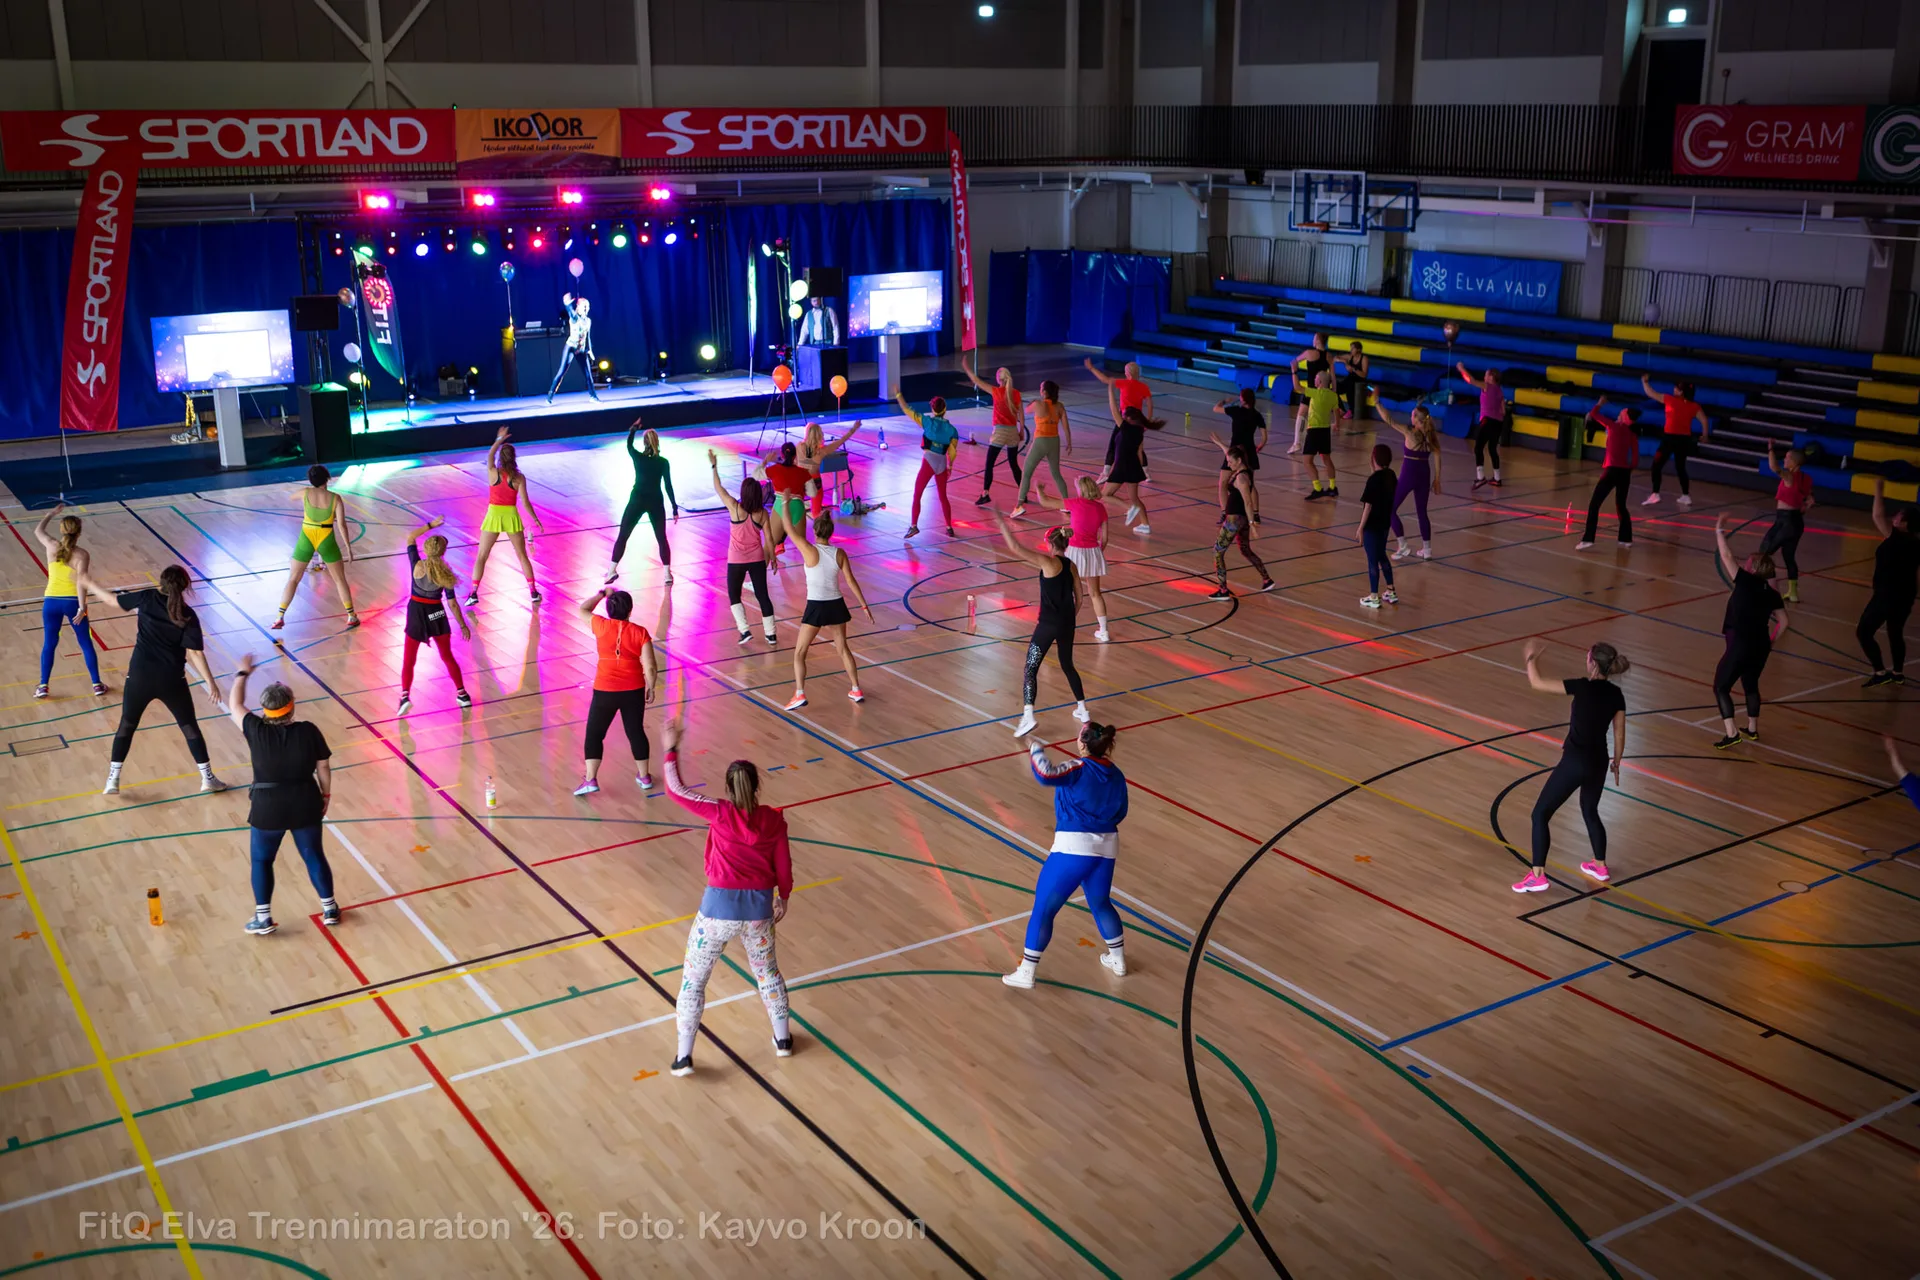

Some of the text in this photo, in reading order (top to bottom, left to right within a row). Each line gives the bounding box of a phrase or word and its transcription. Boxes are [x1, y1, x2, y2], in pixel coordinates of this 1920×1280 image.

[139, 117, 428, 160] SPORTLAND
[493, 111, 584, 141] IKODOR
[718, 113, 927, 151] SPORTLAND
[1743, 152, 1840, 165] WELLNESS DRINK
[82, 170, 124, 344] SPORTLAND
[1504, 280, 1547, 298] VALD
